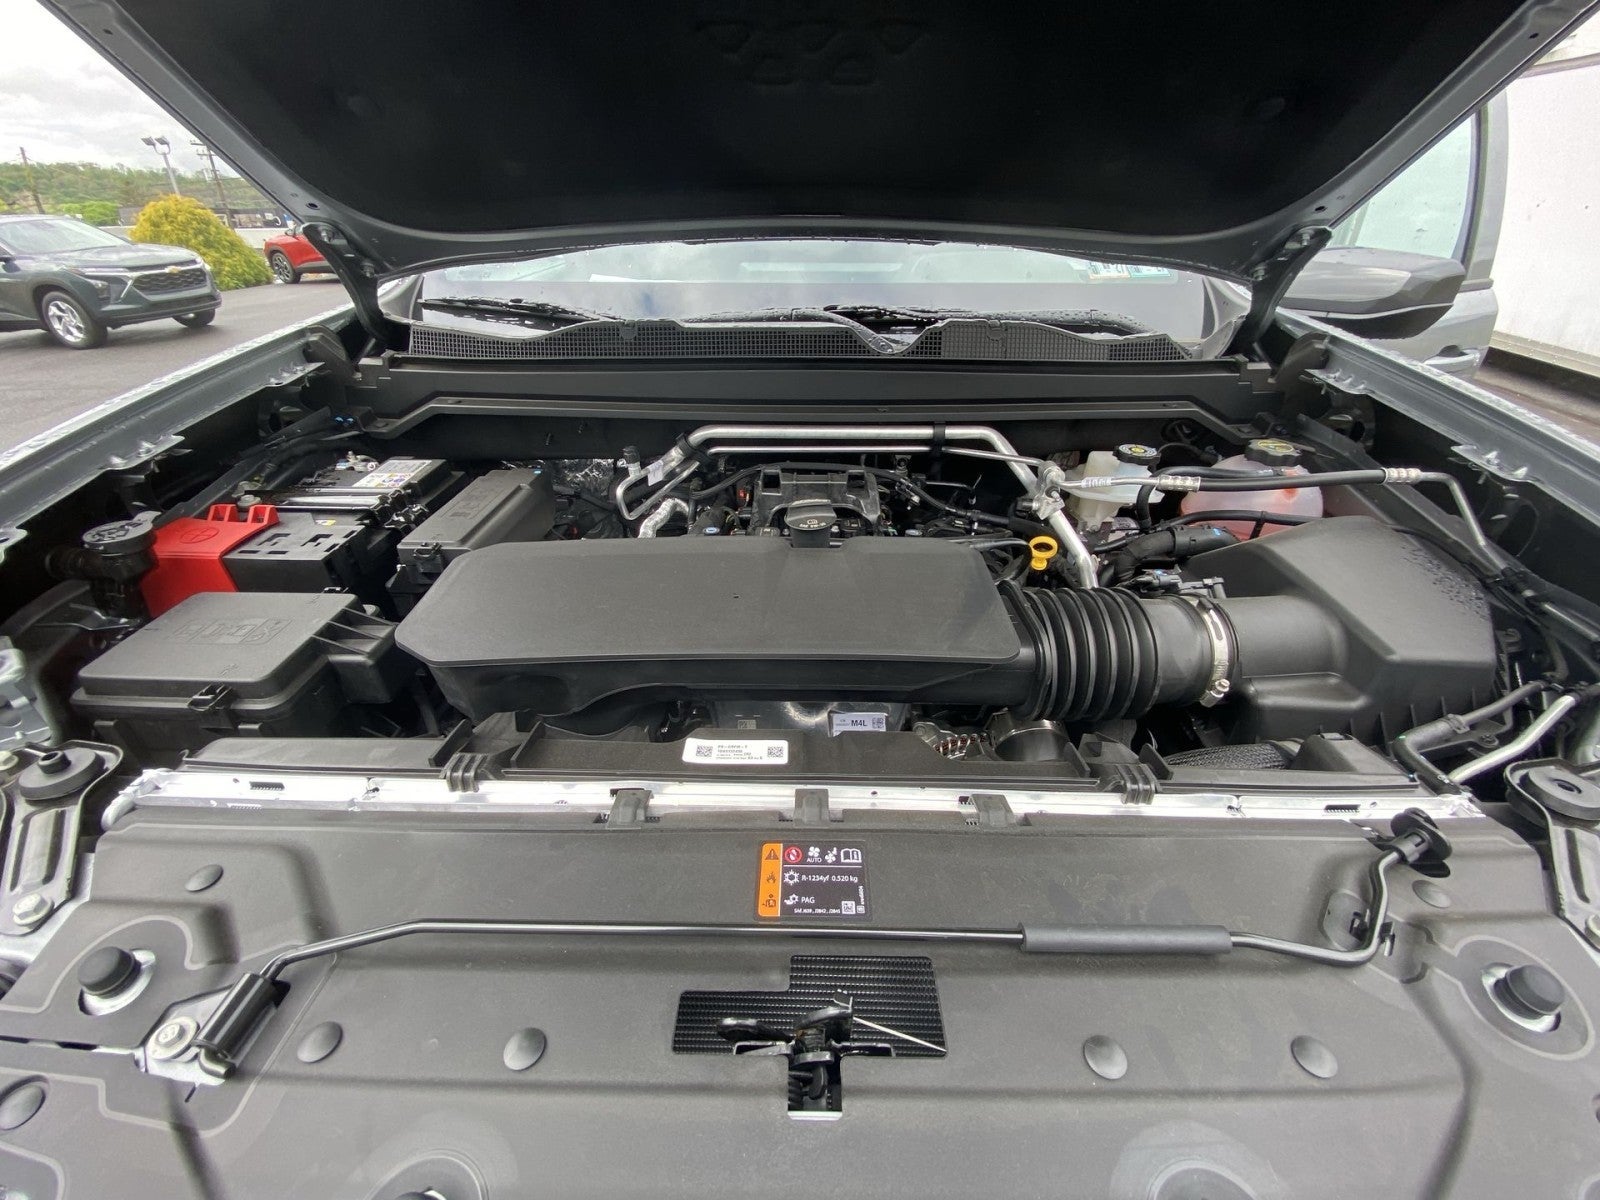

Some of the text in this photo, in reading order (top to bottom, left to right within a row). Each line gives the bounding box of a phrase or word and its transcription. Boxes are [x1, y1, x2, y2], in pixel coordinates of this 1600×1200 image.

[851, 719, 868, 727] M4L
[801, 875, 829, 883] R-1234yf
[850, 875, 858, 883] kg
